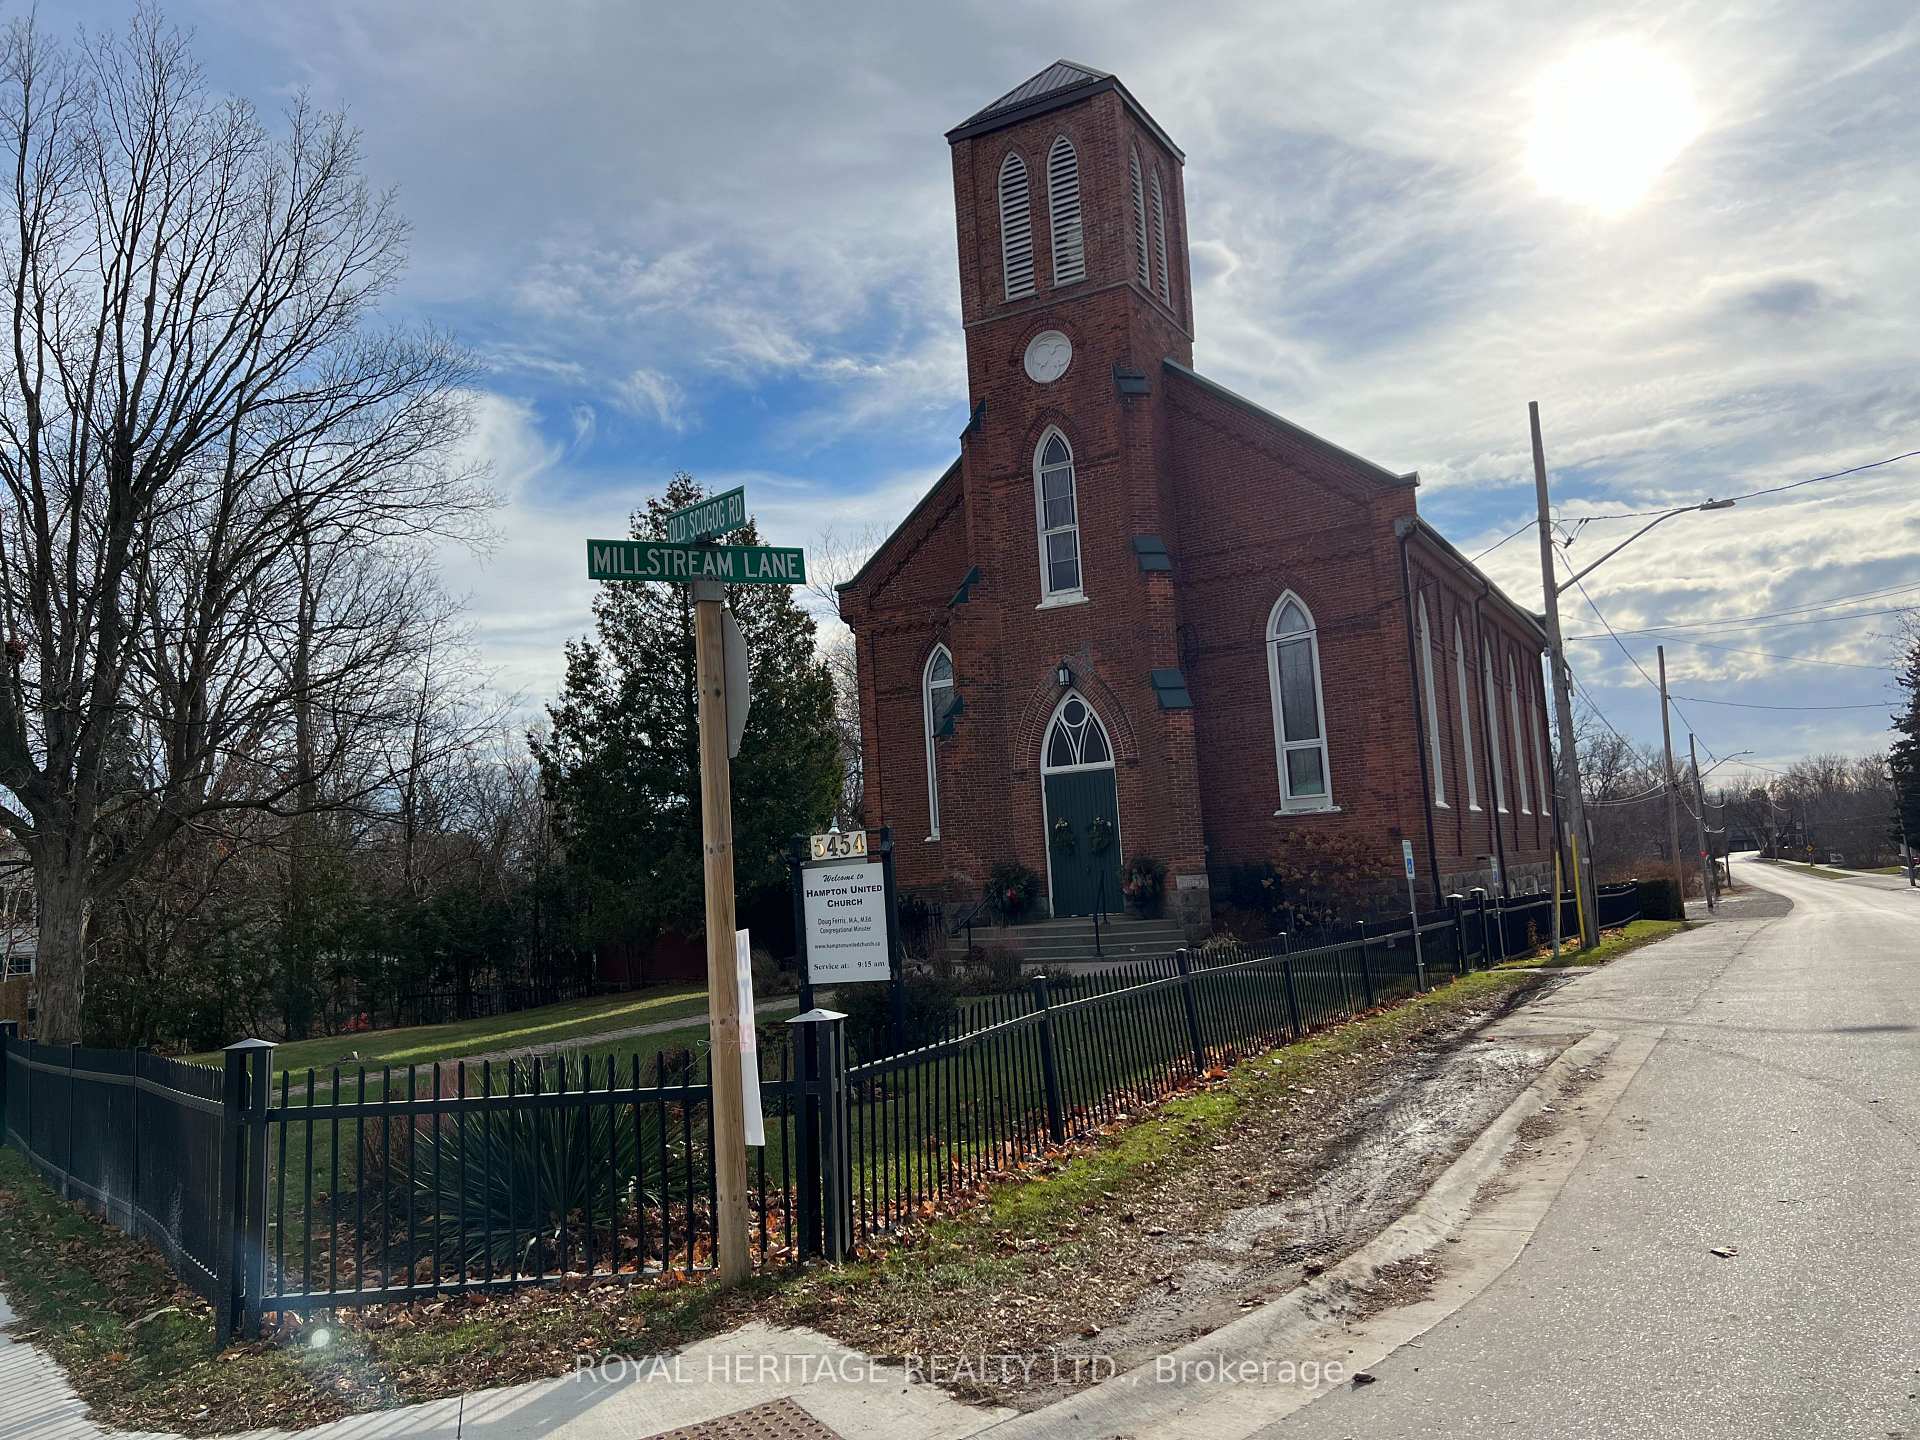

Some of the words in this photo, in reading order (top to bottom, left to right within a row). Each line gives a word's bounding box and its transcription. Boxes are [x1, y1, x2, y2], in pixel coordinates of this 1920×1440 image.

[668, 514, 686, 543] OLD
[689, 501, 725, 538] SCUGOG
[728, 495, 743, 524] RD
[593, 545, 734, 577] MILLSTREAM
[744, 552, 801, 578] LANE
[814, 833, 865, 857] 5454
[822, 873, 855, 882] Welcome
[817, 918, 832, 927] Doug
[814, 962, 839, 971] Service
[857, 960, 872, 968] 9:15
